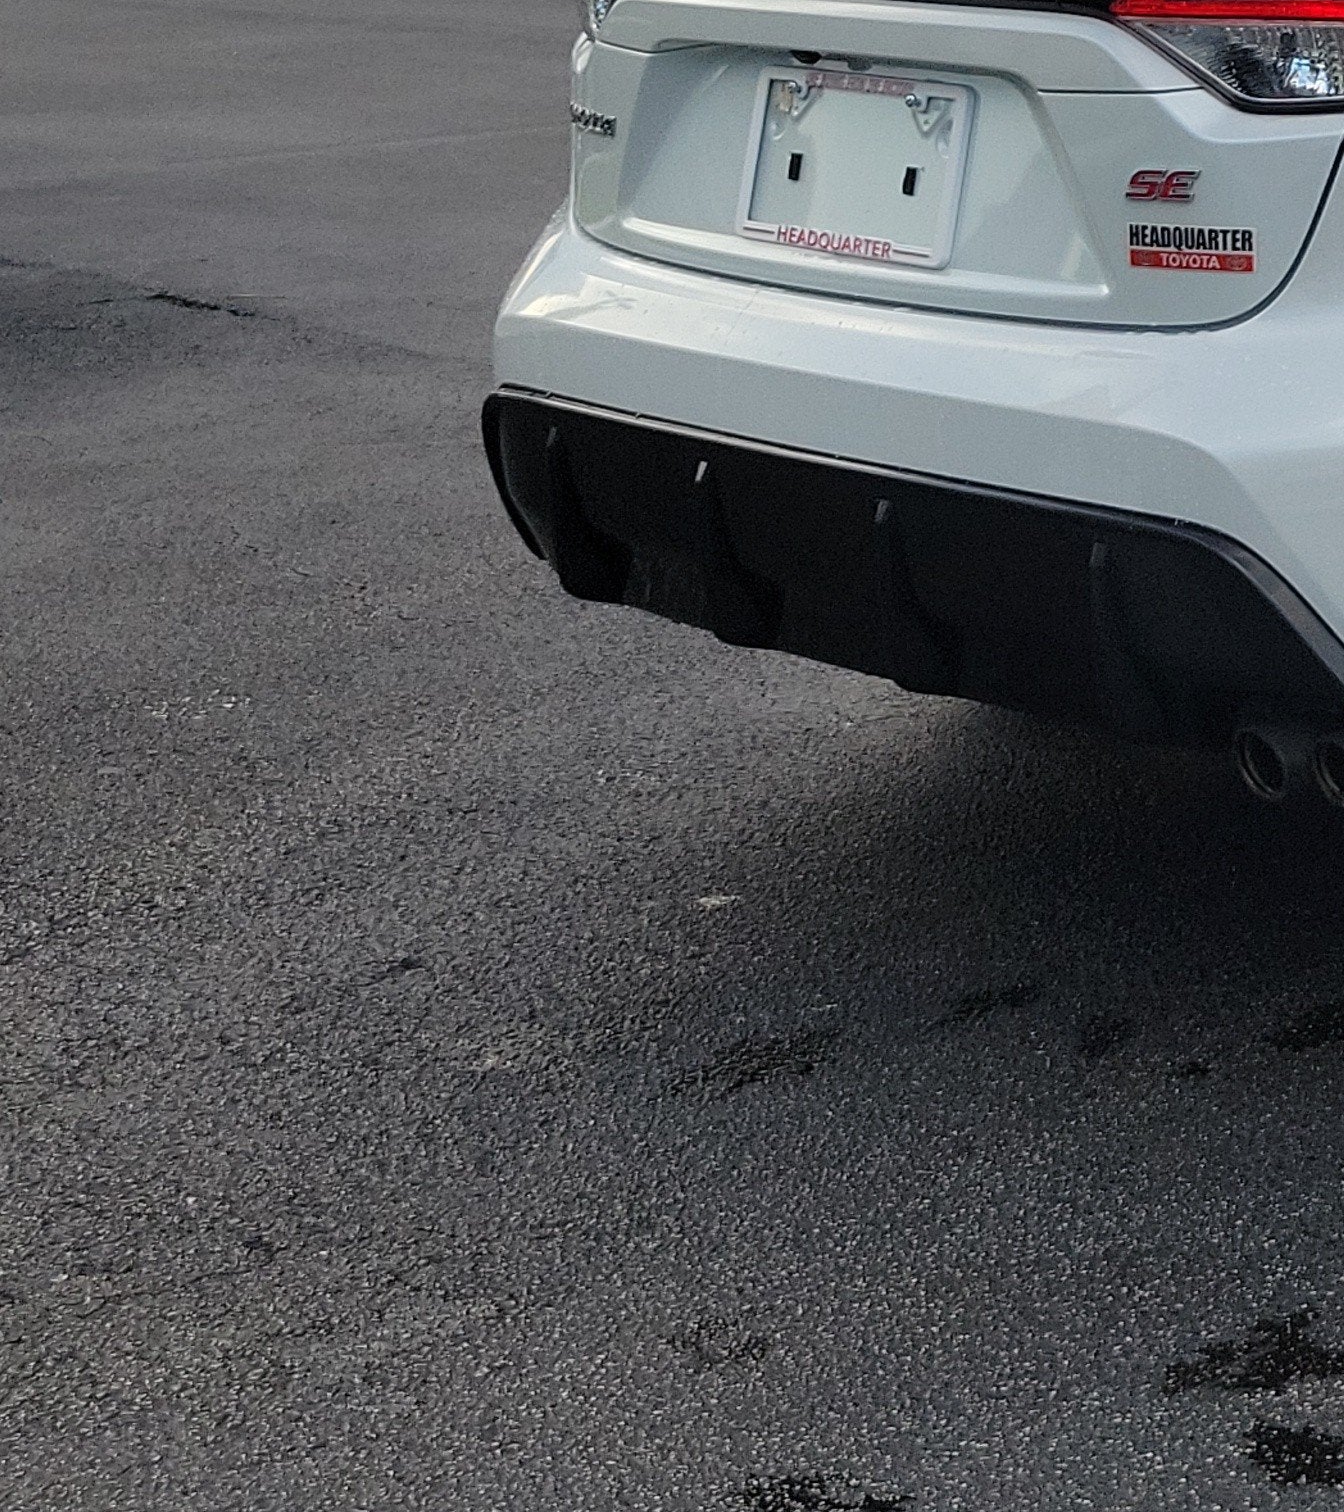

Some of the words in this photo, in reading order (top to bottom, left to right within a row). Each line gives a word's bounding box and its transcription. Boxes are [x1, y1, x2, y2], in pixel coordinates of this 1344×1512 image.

[1125, 169, 1202, 202] SE
[777, 225, 892, 259] HEADQUARTER
[1129, 223, 1254, 252] HEADQUARTER
[1159, 252, 1222, 270] TOYOTA
